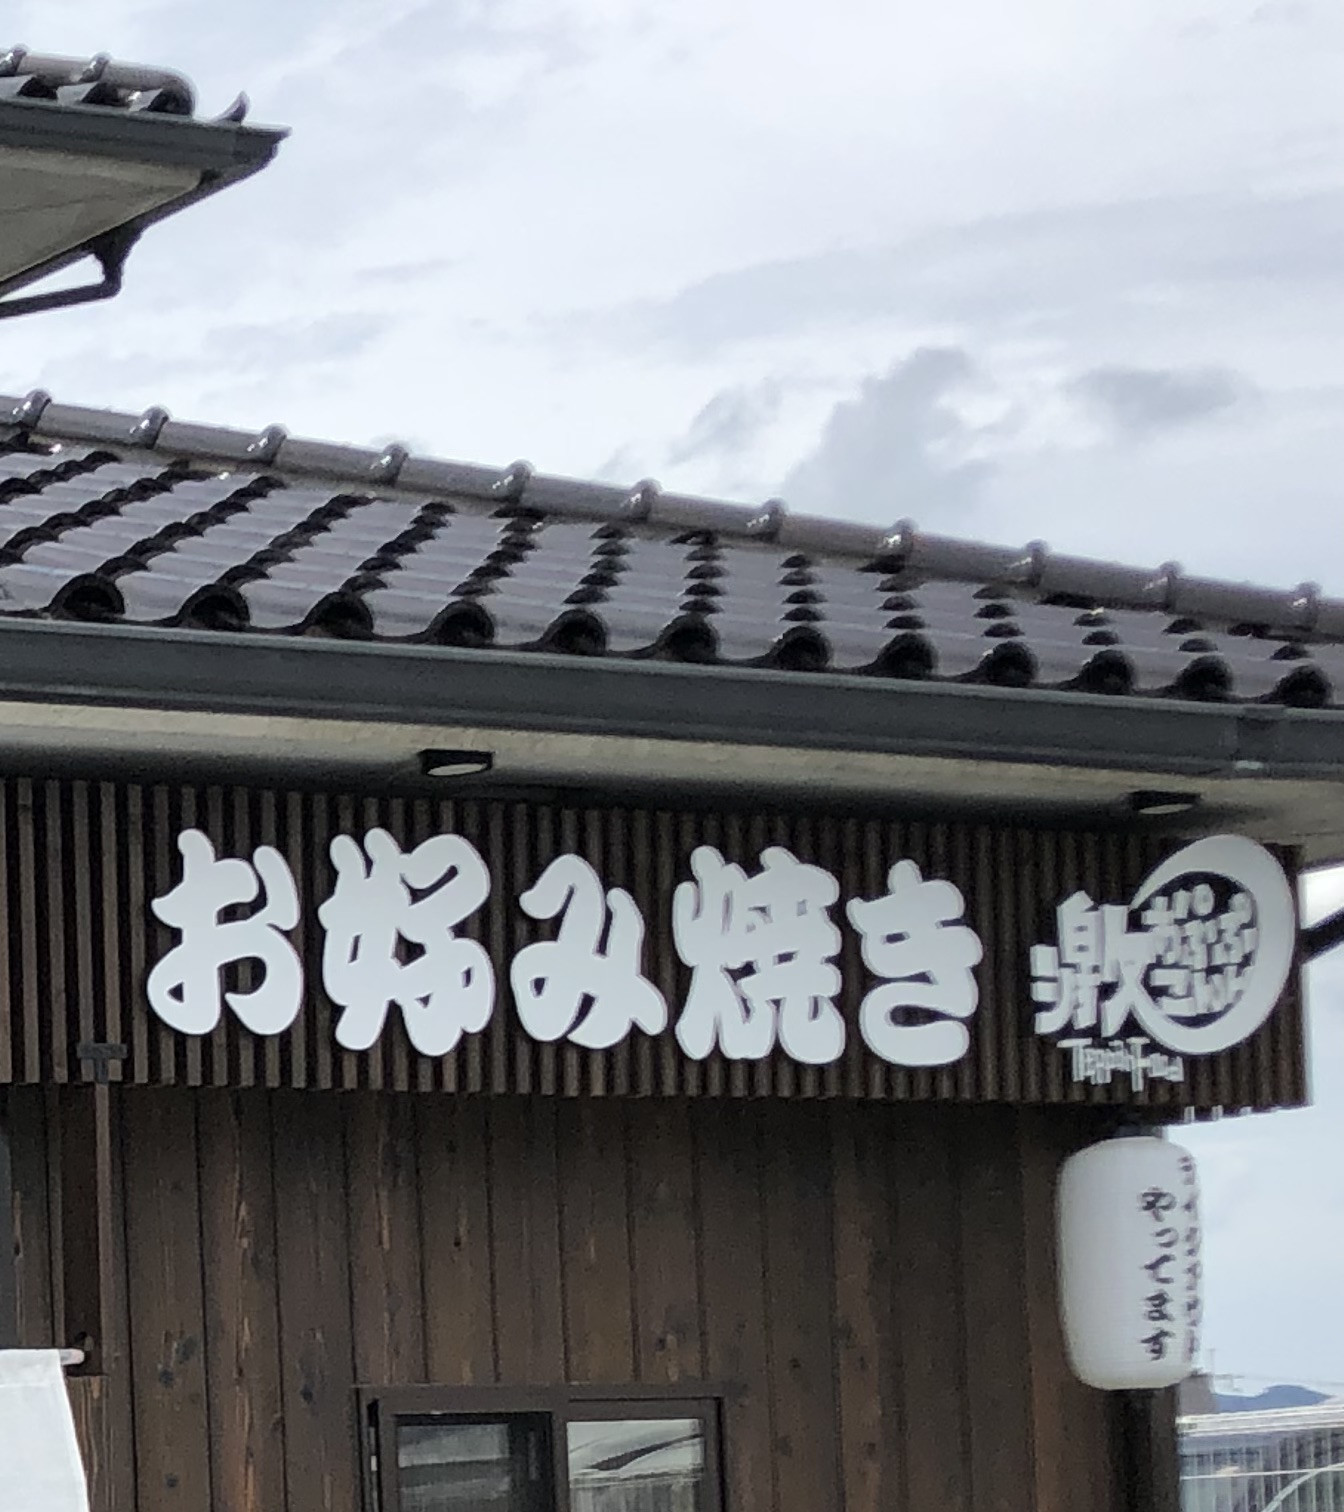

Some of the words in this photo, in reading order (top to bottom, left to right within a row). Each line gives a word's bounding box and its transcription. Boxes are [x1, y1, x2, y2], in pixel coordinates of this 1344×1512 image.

[146, 827, 984, 1066] お好み焼き
